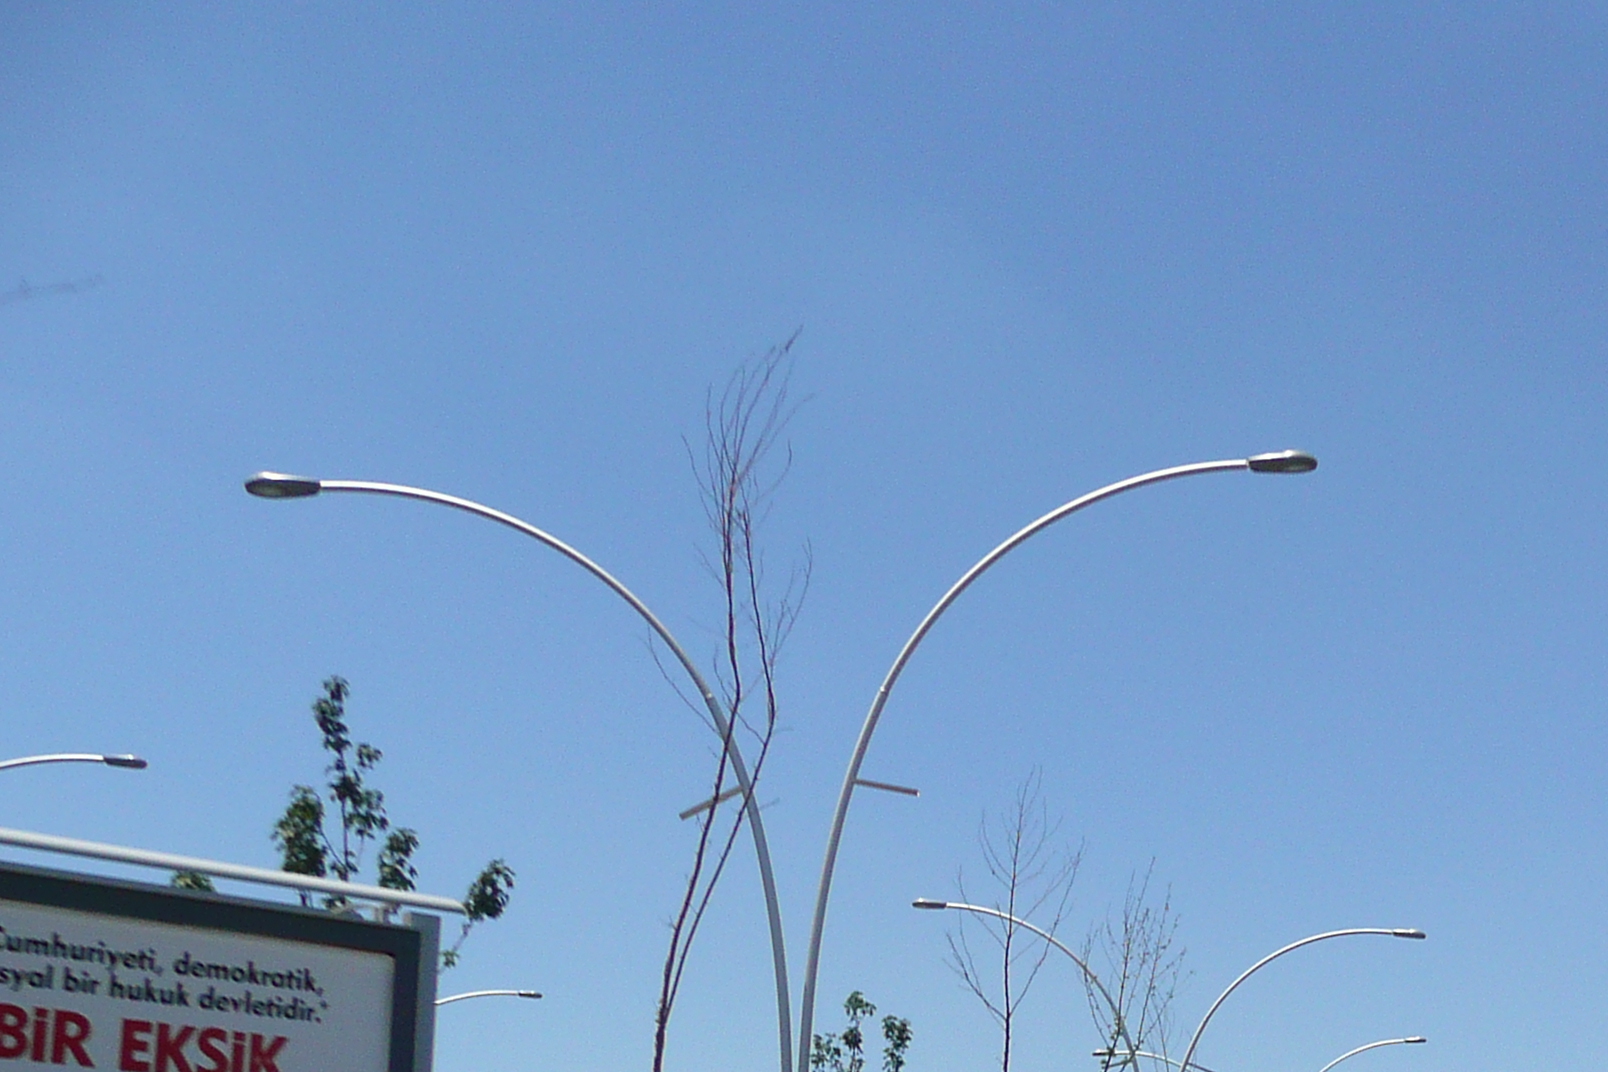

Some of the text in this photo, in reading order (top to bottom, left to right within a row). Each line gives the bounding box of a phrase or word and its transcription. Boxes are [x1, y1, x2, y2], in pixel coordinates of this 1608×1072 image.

[63, 966, 101, 995] bir
[109, 972, 191, 1007] hukuk
[173, 951, 324, 997] demokratik,
